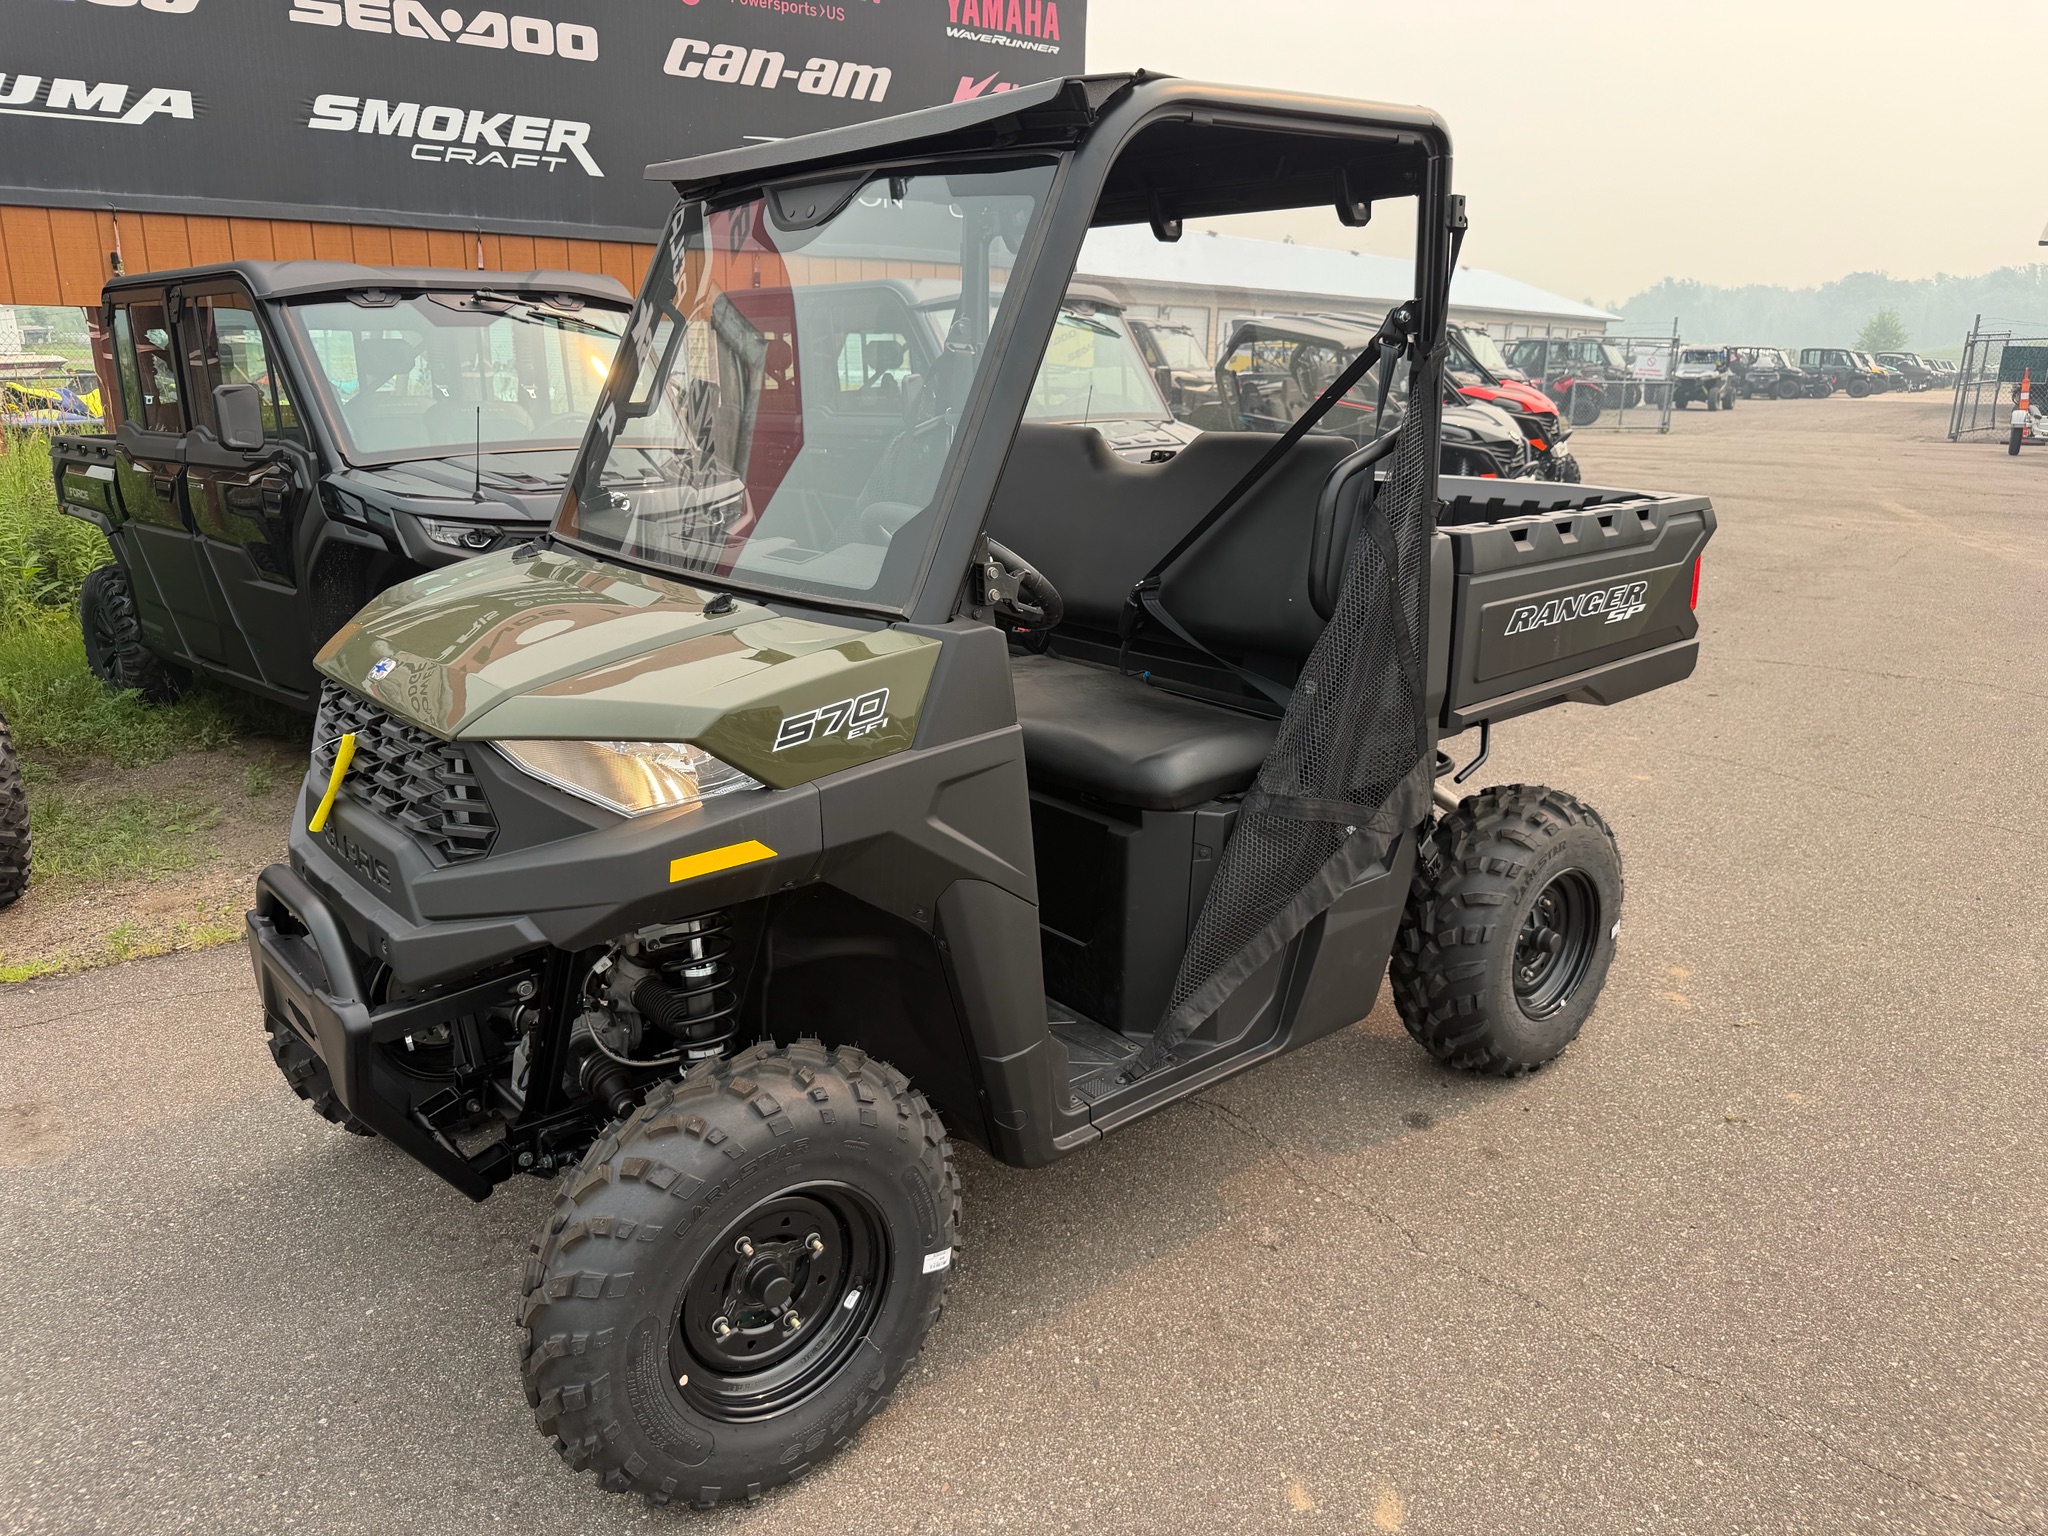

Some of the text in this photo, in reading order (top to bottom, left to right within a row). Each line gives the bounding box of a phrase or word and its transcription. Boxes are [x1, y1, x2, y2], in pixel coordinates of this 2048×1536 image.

[947, 0, 1060, 41] YAMAHA
[308, 94, 605, 177] SMOKER
[410, 144, 568, 173] CRAFT
[1504, 581, 1648, 636] RANGER
[1604, 603, 1647, 624] SP
[772, 687, 890, 753] 570
[847, 717, 889, 740] EFI
[316, 810, 392, 893] OLARIS
[673, 1137, 812, 1240] CARLSTAR
